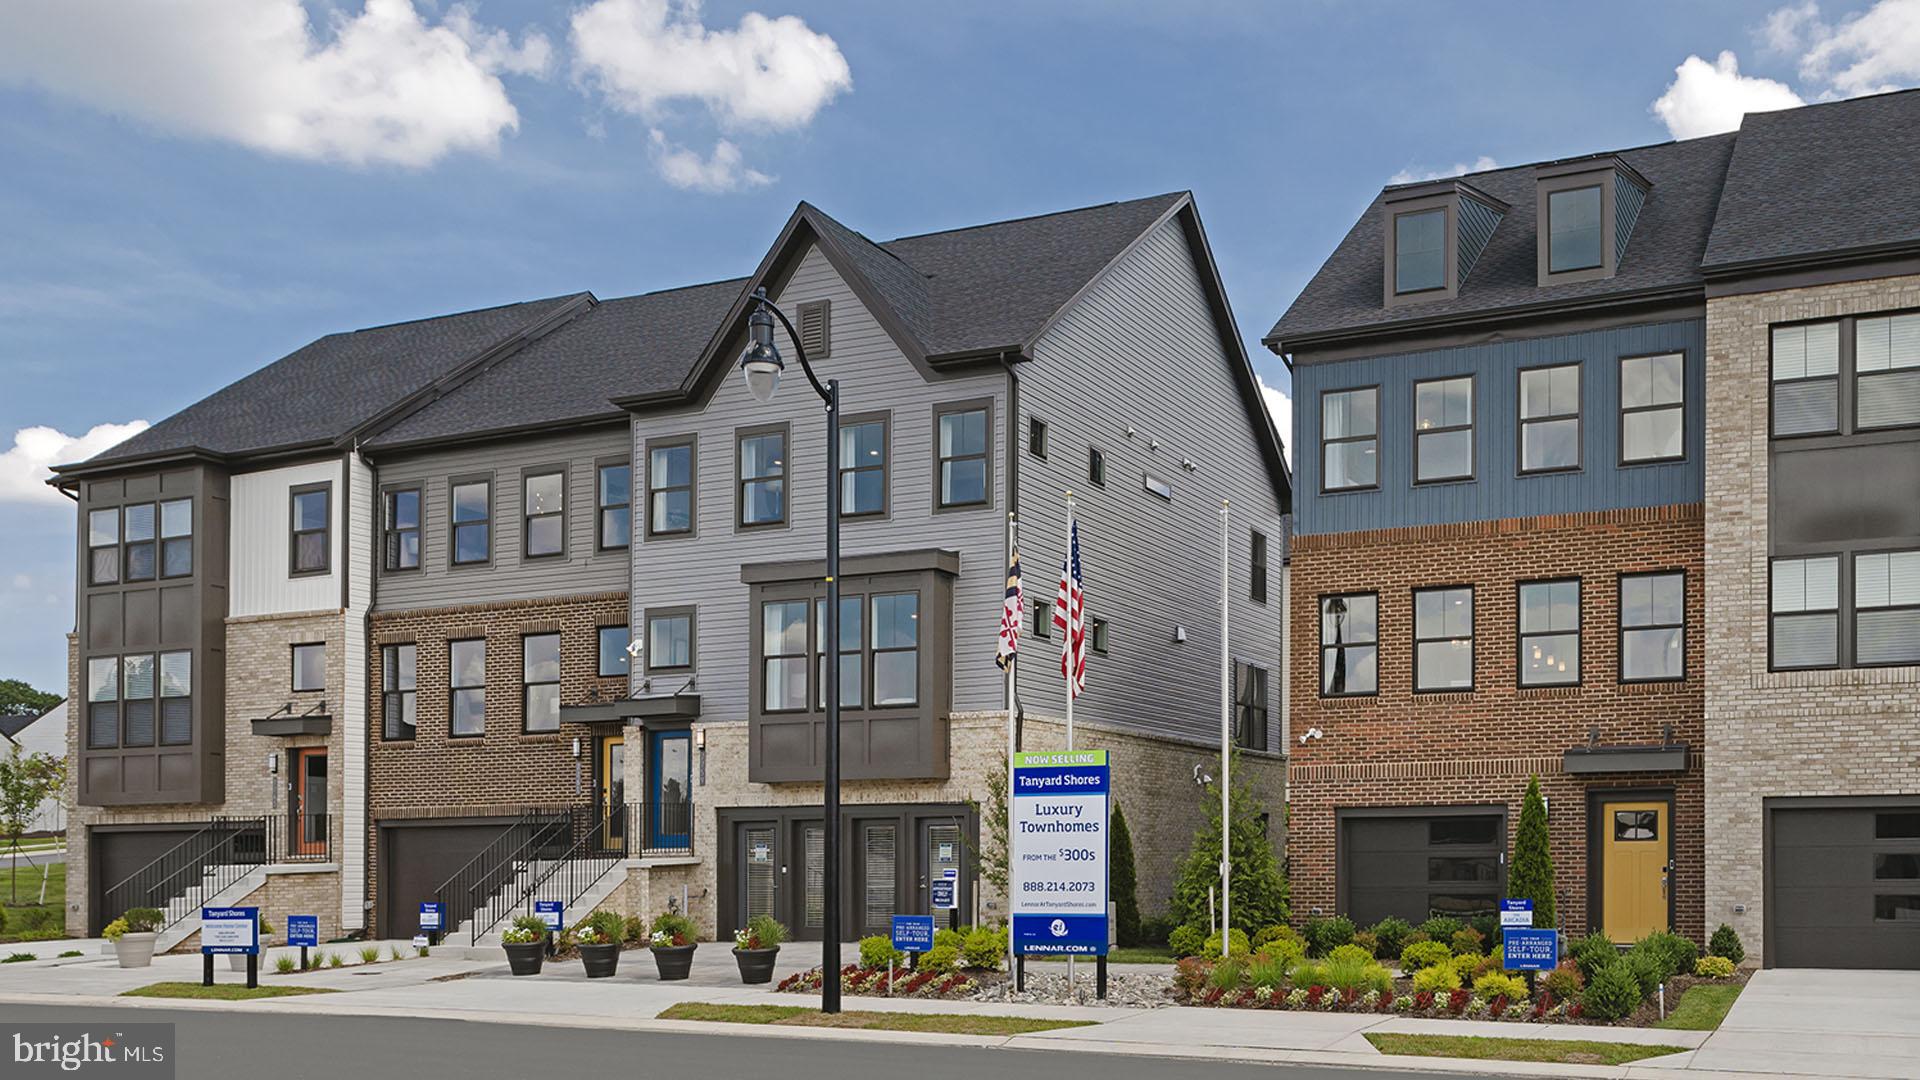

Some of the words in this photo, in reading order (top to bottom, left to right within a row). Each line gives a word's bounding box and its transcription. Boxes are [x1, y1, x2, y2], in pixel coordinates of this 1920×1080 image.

[1025, 755, 1049, 764] NOW
[1051, 754, 1095, 764] SELLING
[1019, 775, 1062, 788] Tanyard
[1064, 774, 1101, 786] Shores
[1036, 804, 1083, 818] Luxury
[1020, 821, 1100, 833] Townhomes
[1059, 848, 1096, 861] $300s
[1023, 882, 1095, 892] 888.214.2073
[208, 910, 228, 918] Tanyard
[1024, 945, 1088, 953] LENNAR.COM
[1508, 946, 1553, 954] SELF-TOUR,
